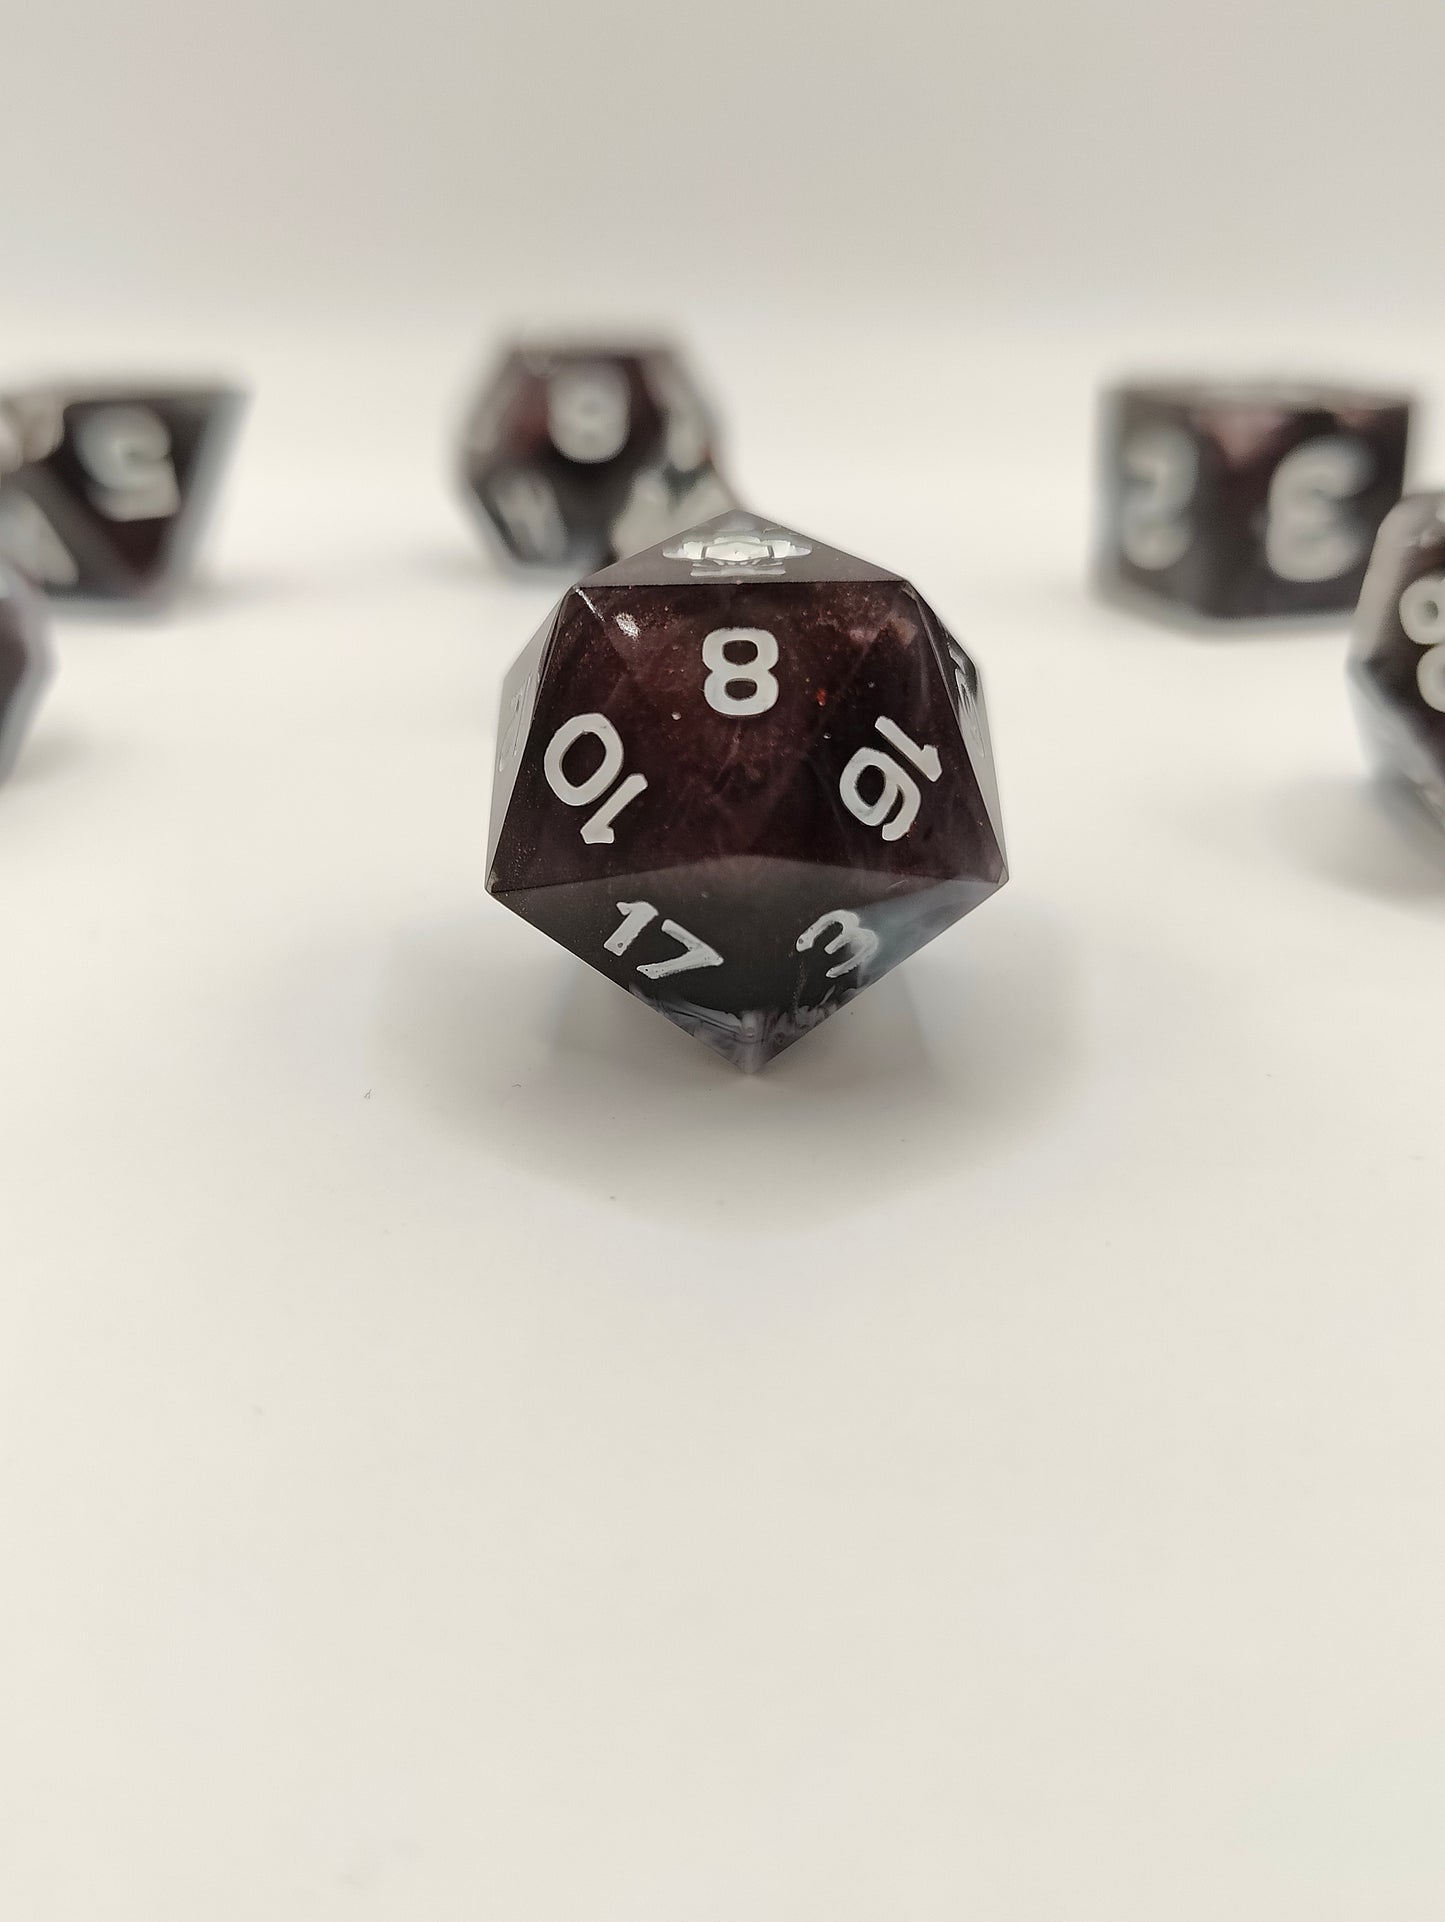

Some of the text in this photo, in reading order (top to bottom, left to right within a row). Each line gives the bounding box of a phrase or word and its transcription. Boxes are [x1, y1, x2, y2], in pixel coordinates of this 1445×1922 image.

[702, 628, 778, 715] 8
[544, 713, 647, 844] 10
[840, 716, 942, 841] 16
[604, 901, 724, 979] 17
[796, 910, 880, 977] 3
